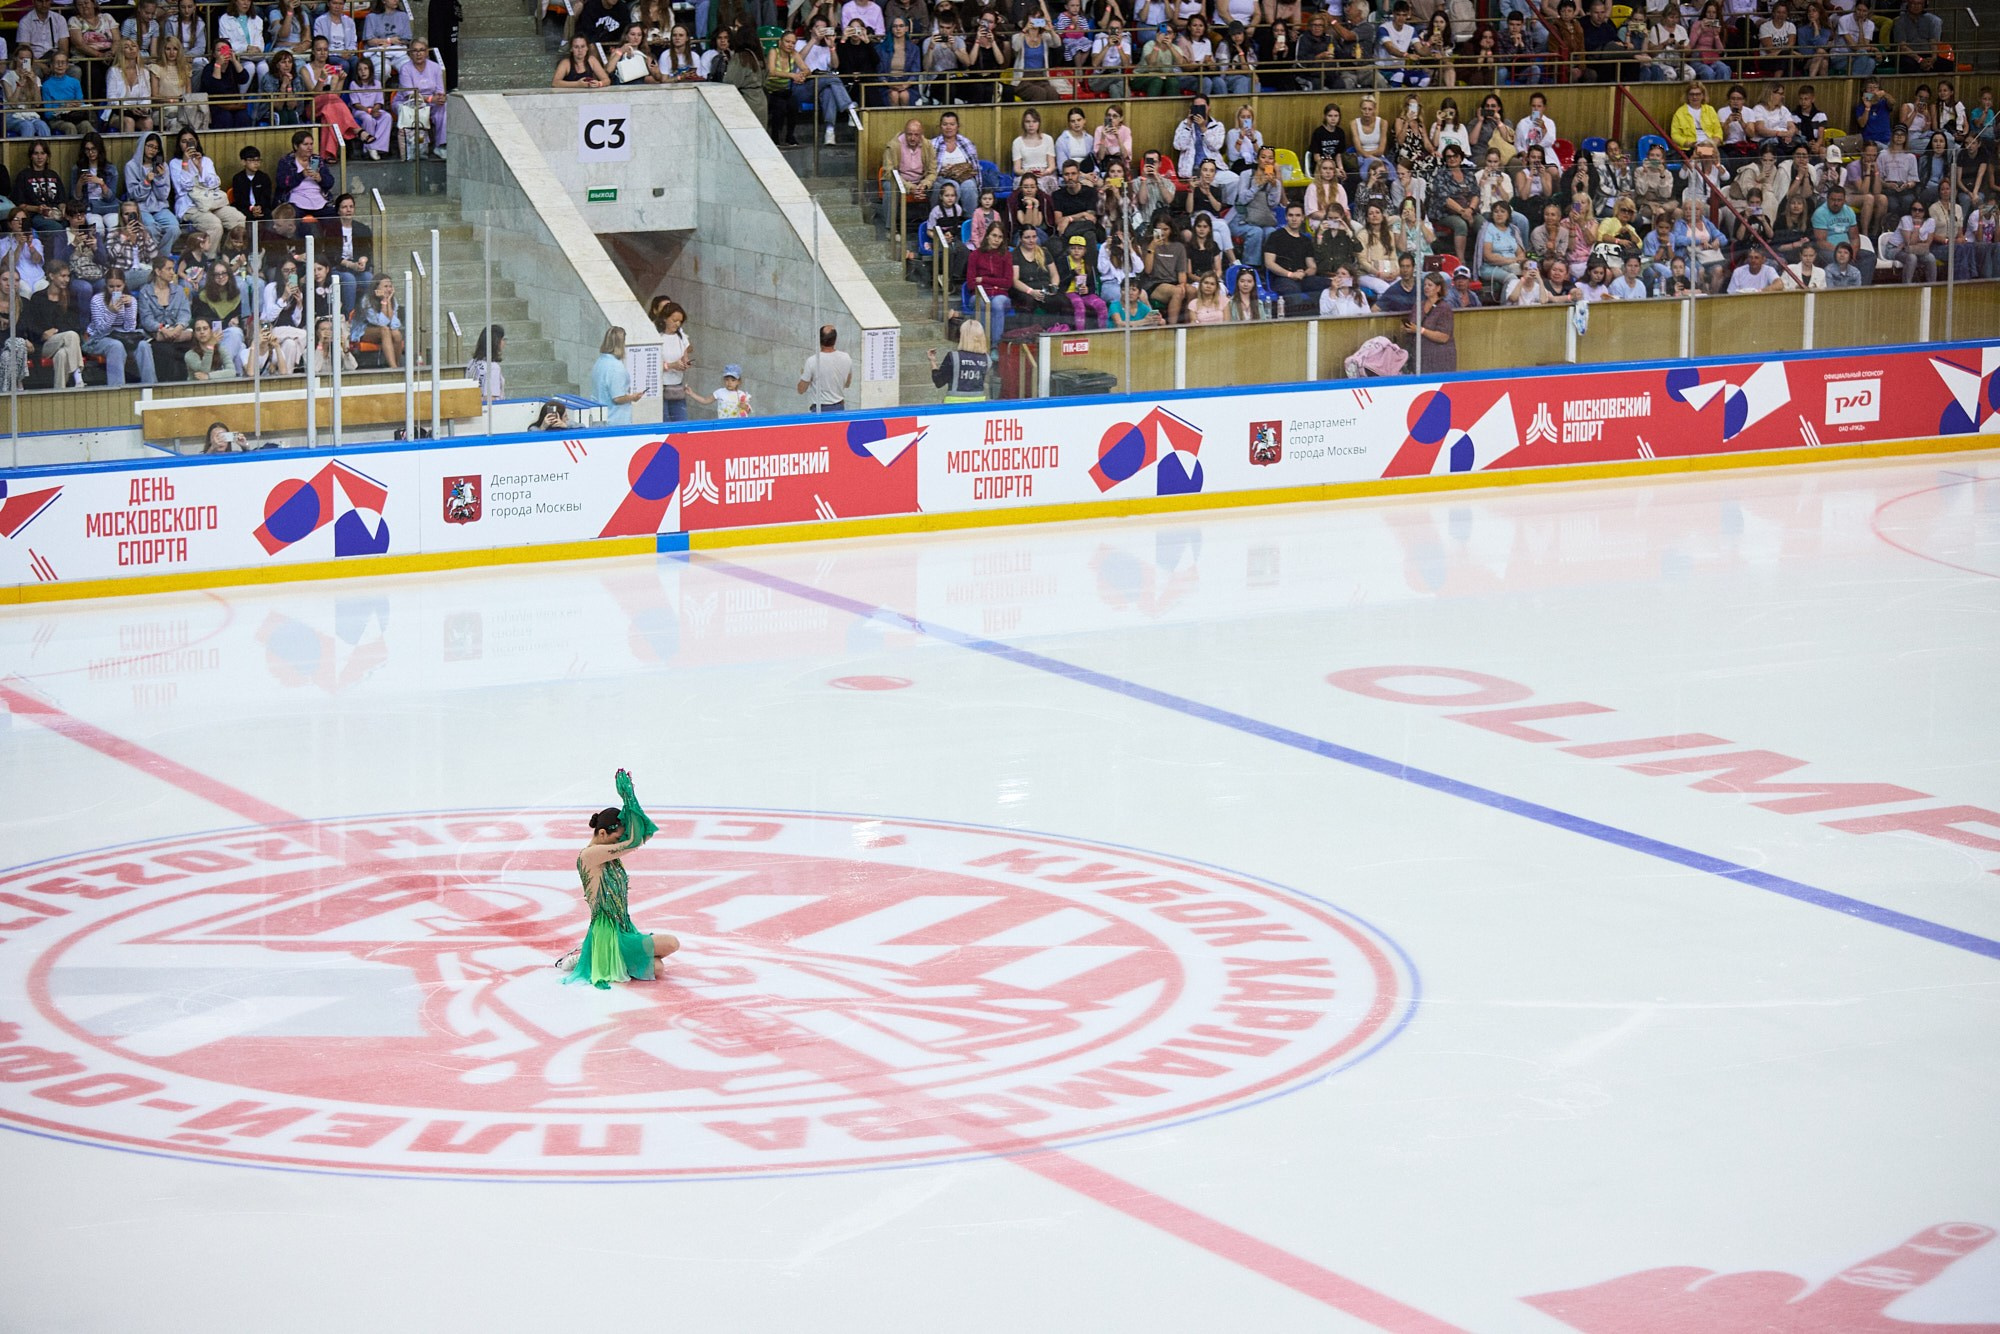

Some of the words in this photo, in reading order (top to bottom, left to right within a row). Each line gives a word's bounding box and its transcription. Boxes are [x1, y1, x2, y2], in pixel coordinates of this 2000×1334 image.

[584, 118, 626, 149] С3
[1823, 371, 1861, 380] ОФИЦИАЛЬНЫЙ
[1862, 370, 1884, 378] СПОНСОР
[1563, 391, 1651, 421] МОСКОВСКИЙ
[984, 419, 1023, 445] ДЕНЬ
[1289, 417, 1358, 433] Департамент
[1563, 419, 1605, 443] СПОРТ
[1289, 434, 1325, 447] спорта
[1289, 449, 1325, 462] города
[1328, 445, 1367, 457] Москвы
[725, 446, 830, 481] МОСКОВСКИЙ
[947, 445, 1059, 474] МОСКОВСКОГО
[128, 477, 175, 506] ДЕНЬ
[490, 471, 570, 488] Департамент
[725, 478, 775, 505] СПОРТ
[974, 474, 1033, 500] СПОРТА
[490, 488, 532, 503] спорта
[85, 506, 218, 539] МОСКОВСКОГО
[490, 505, 533, 519] города
[535, 502, 583, 515] Москвы
[117, 537, 188, 567] СПОРТА
[1323, 664, 2000, 876] OLIMP
[962, 848, 1312, 947] КУБОК
[701, 956, 1338, 1151] ХАРЛАМОВА
[0, 1021, 643, 1156] ПЛЕЙ-ОФ
